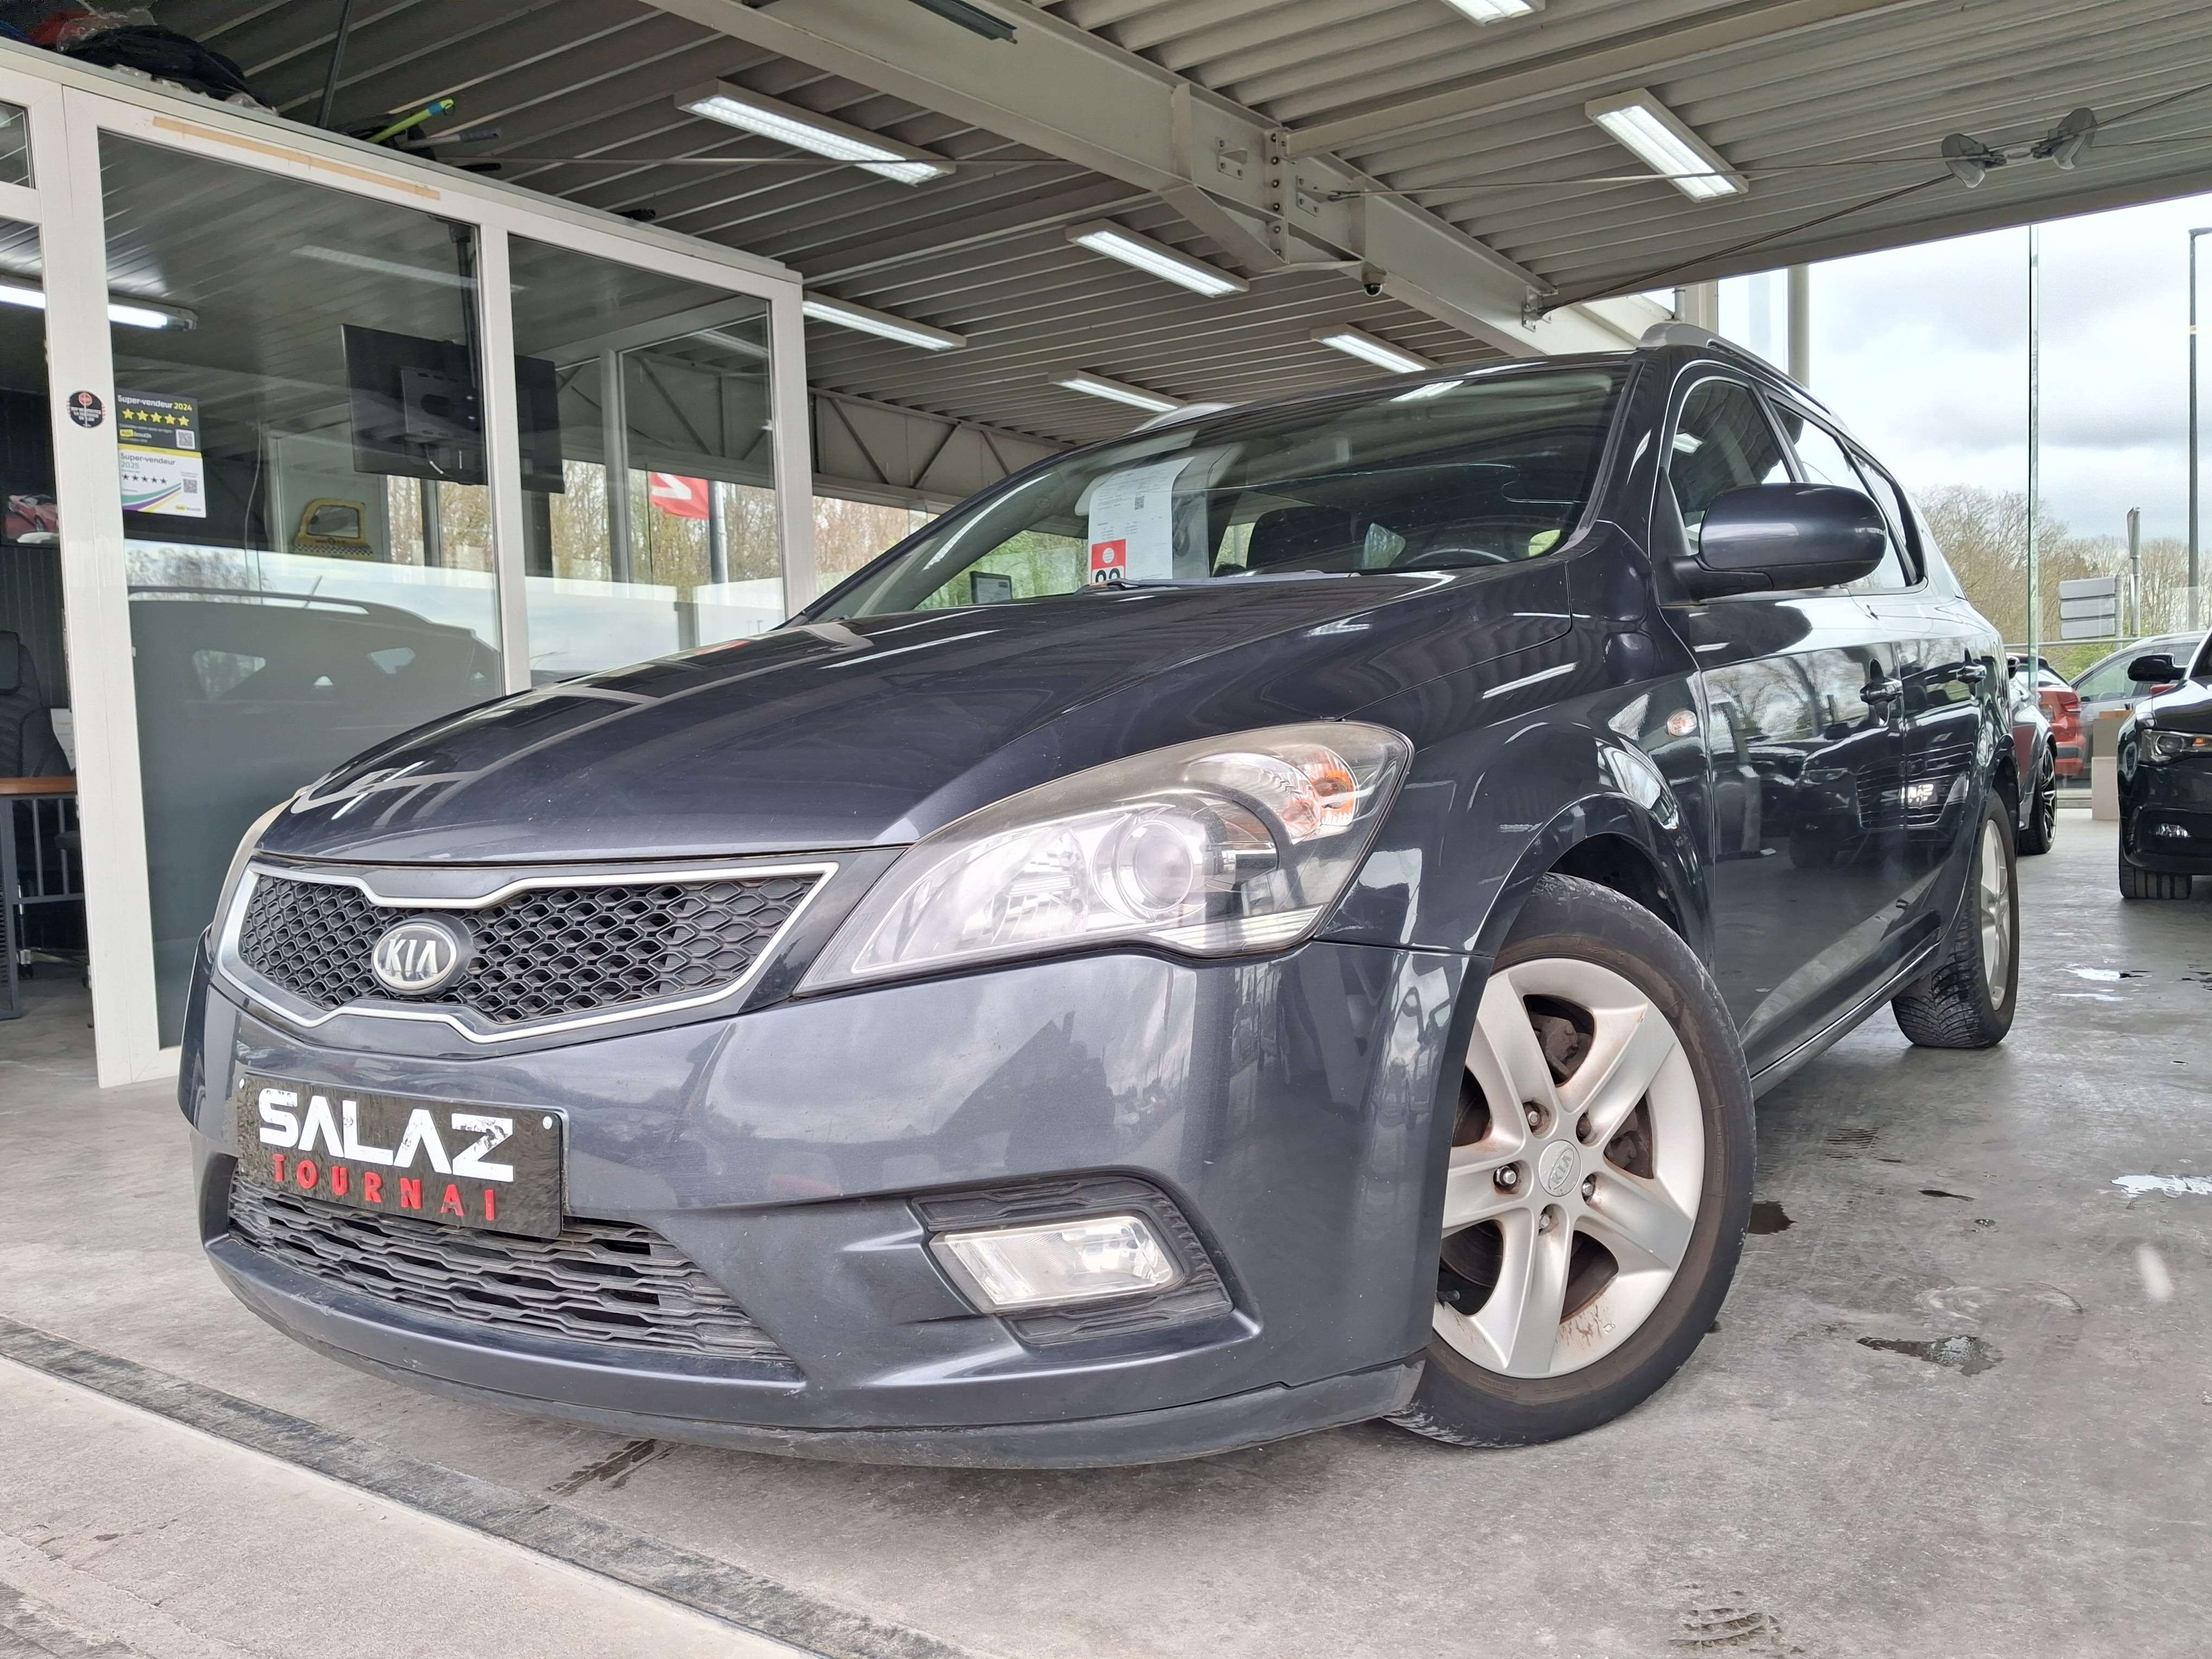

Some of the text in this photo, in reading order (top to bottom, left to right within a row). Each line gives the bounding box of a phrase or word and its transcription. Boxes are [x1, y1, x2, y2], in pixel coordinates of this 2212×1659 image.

[117, 395, 192, 411] Super-vendeur 2024
[120, 453, 176, 466] Super-vendeur
[384, 934, 439, 974] KIA
[258, 1087, 514, 1182] SALAZ
[271, 1153, 496, 1221] TOURNAI
